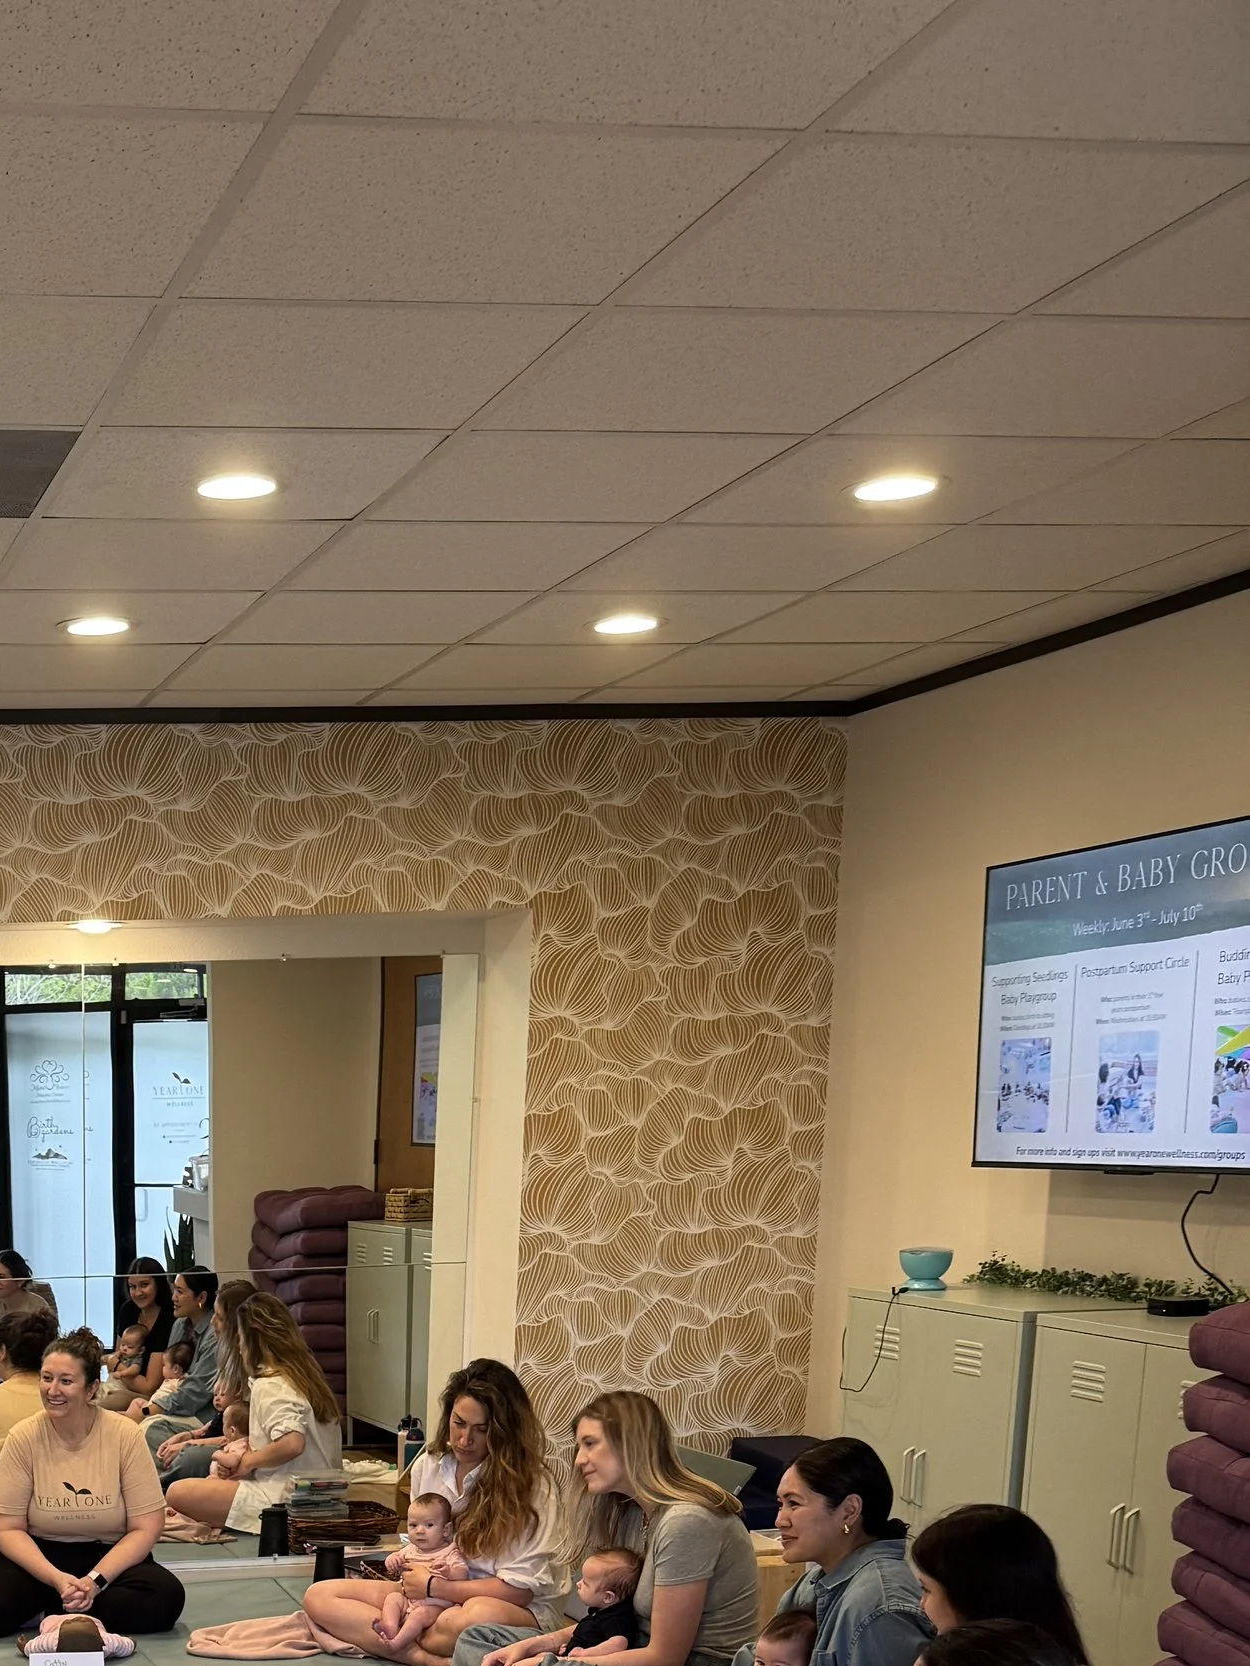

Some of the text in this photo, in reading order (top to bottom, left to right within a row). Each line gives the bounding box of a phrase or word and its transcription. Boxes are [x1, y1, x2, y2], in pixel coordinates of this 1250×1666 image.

[1006, 843, 1247, 910] PARENT & BABY GRO
[1073, 922, 1110, 937] Weekly:
[1110, 918, 1134, 932] June
[1158, 911, 1180, 927] July
[1182, 903, 1203, 922] 10th
[1081, 956, 1190, 978] Postpartum Support Circle
[992, 970, 1069, 988] Supporting Seedlings
[1218, 972, 1241, 985] Baby
[1000, 992, 1057, 1006] Baby Playgroup
[153, 1085, 205, 1096] YEAR ONE
[27, 1116, 58, 1138] Birth
[1059, 1147, 1071, 1156] and
[37, 1495, 112, 1507] YEAR ONE
